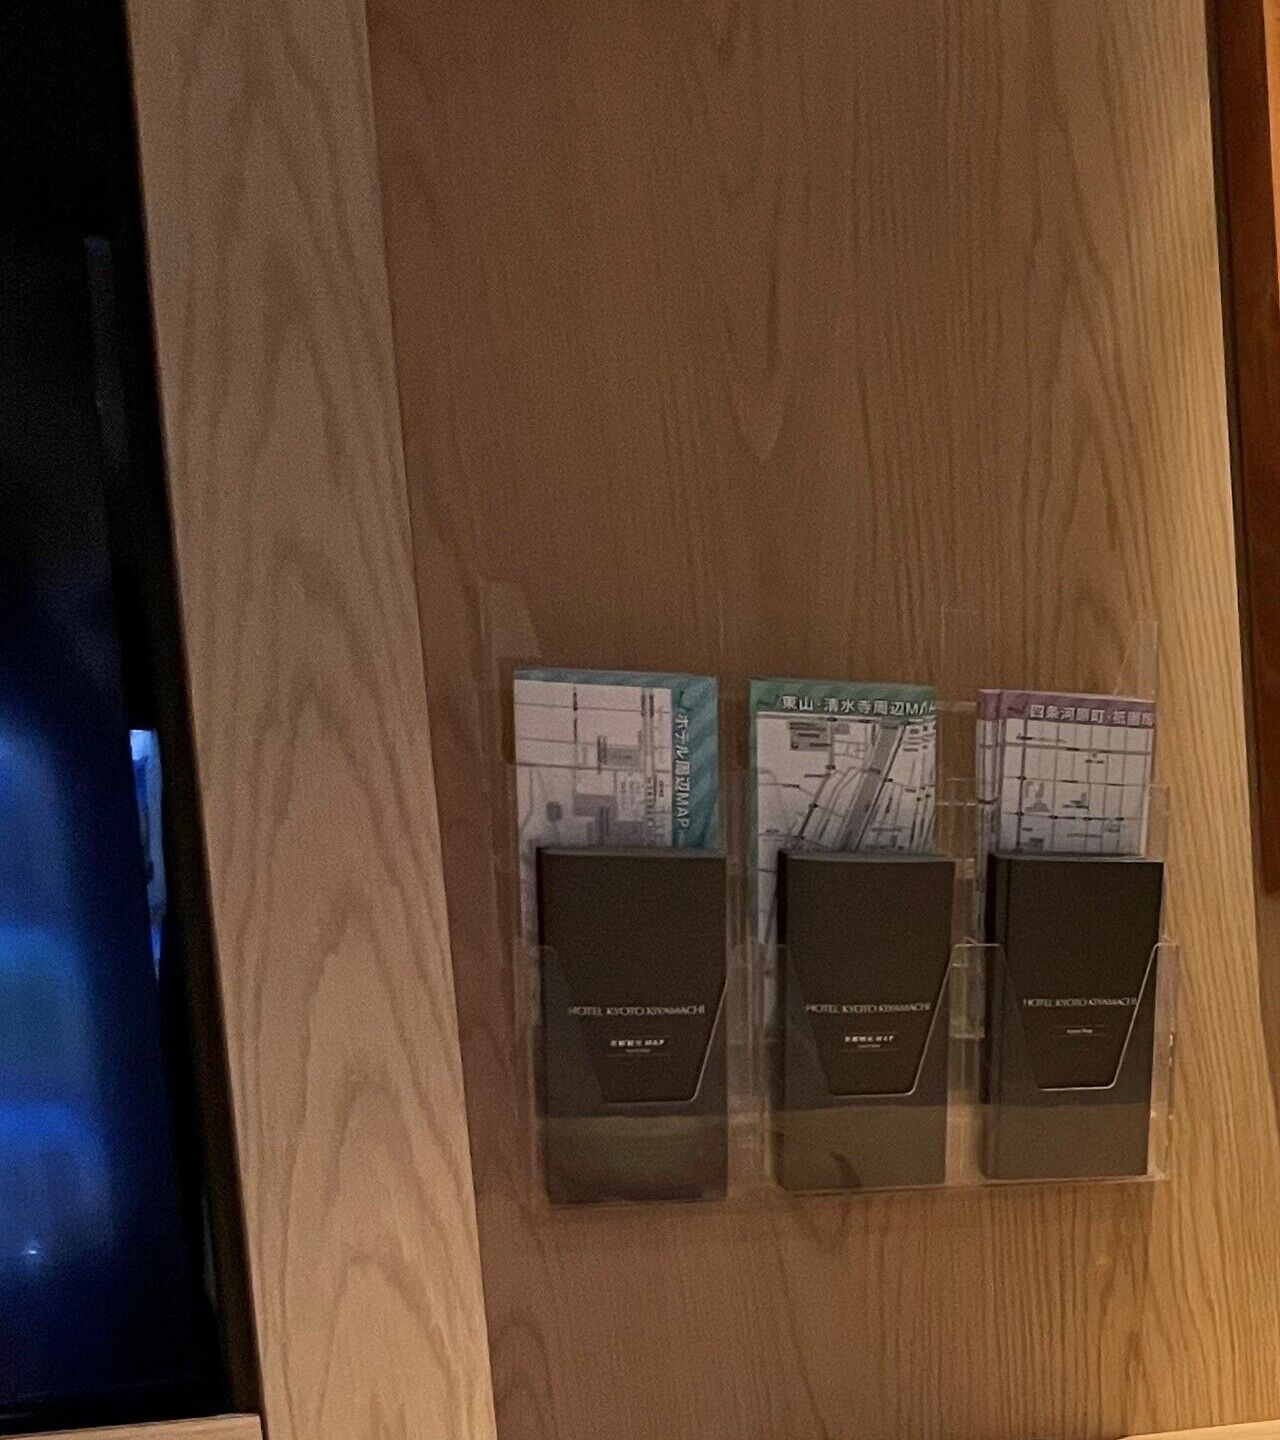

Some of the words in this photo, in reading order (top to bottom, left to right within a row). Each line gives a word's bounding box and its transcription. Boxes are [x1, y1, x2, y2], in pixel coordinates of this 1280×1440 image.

[568, 1005, 602, 1017] HOTEL
[606, 1004, 645, 1016] KYOTO
[805, 1003, 840, 1015] HOTEL
[842, 1003, 877, 1015] KYOTO
